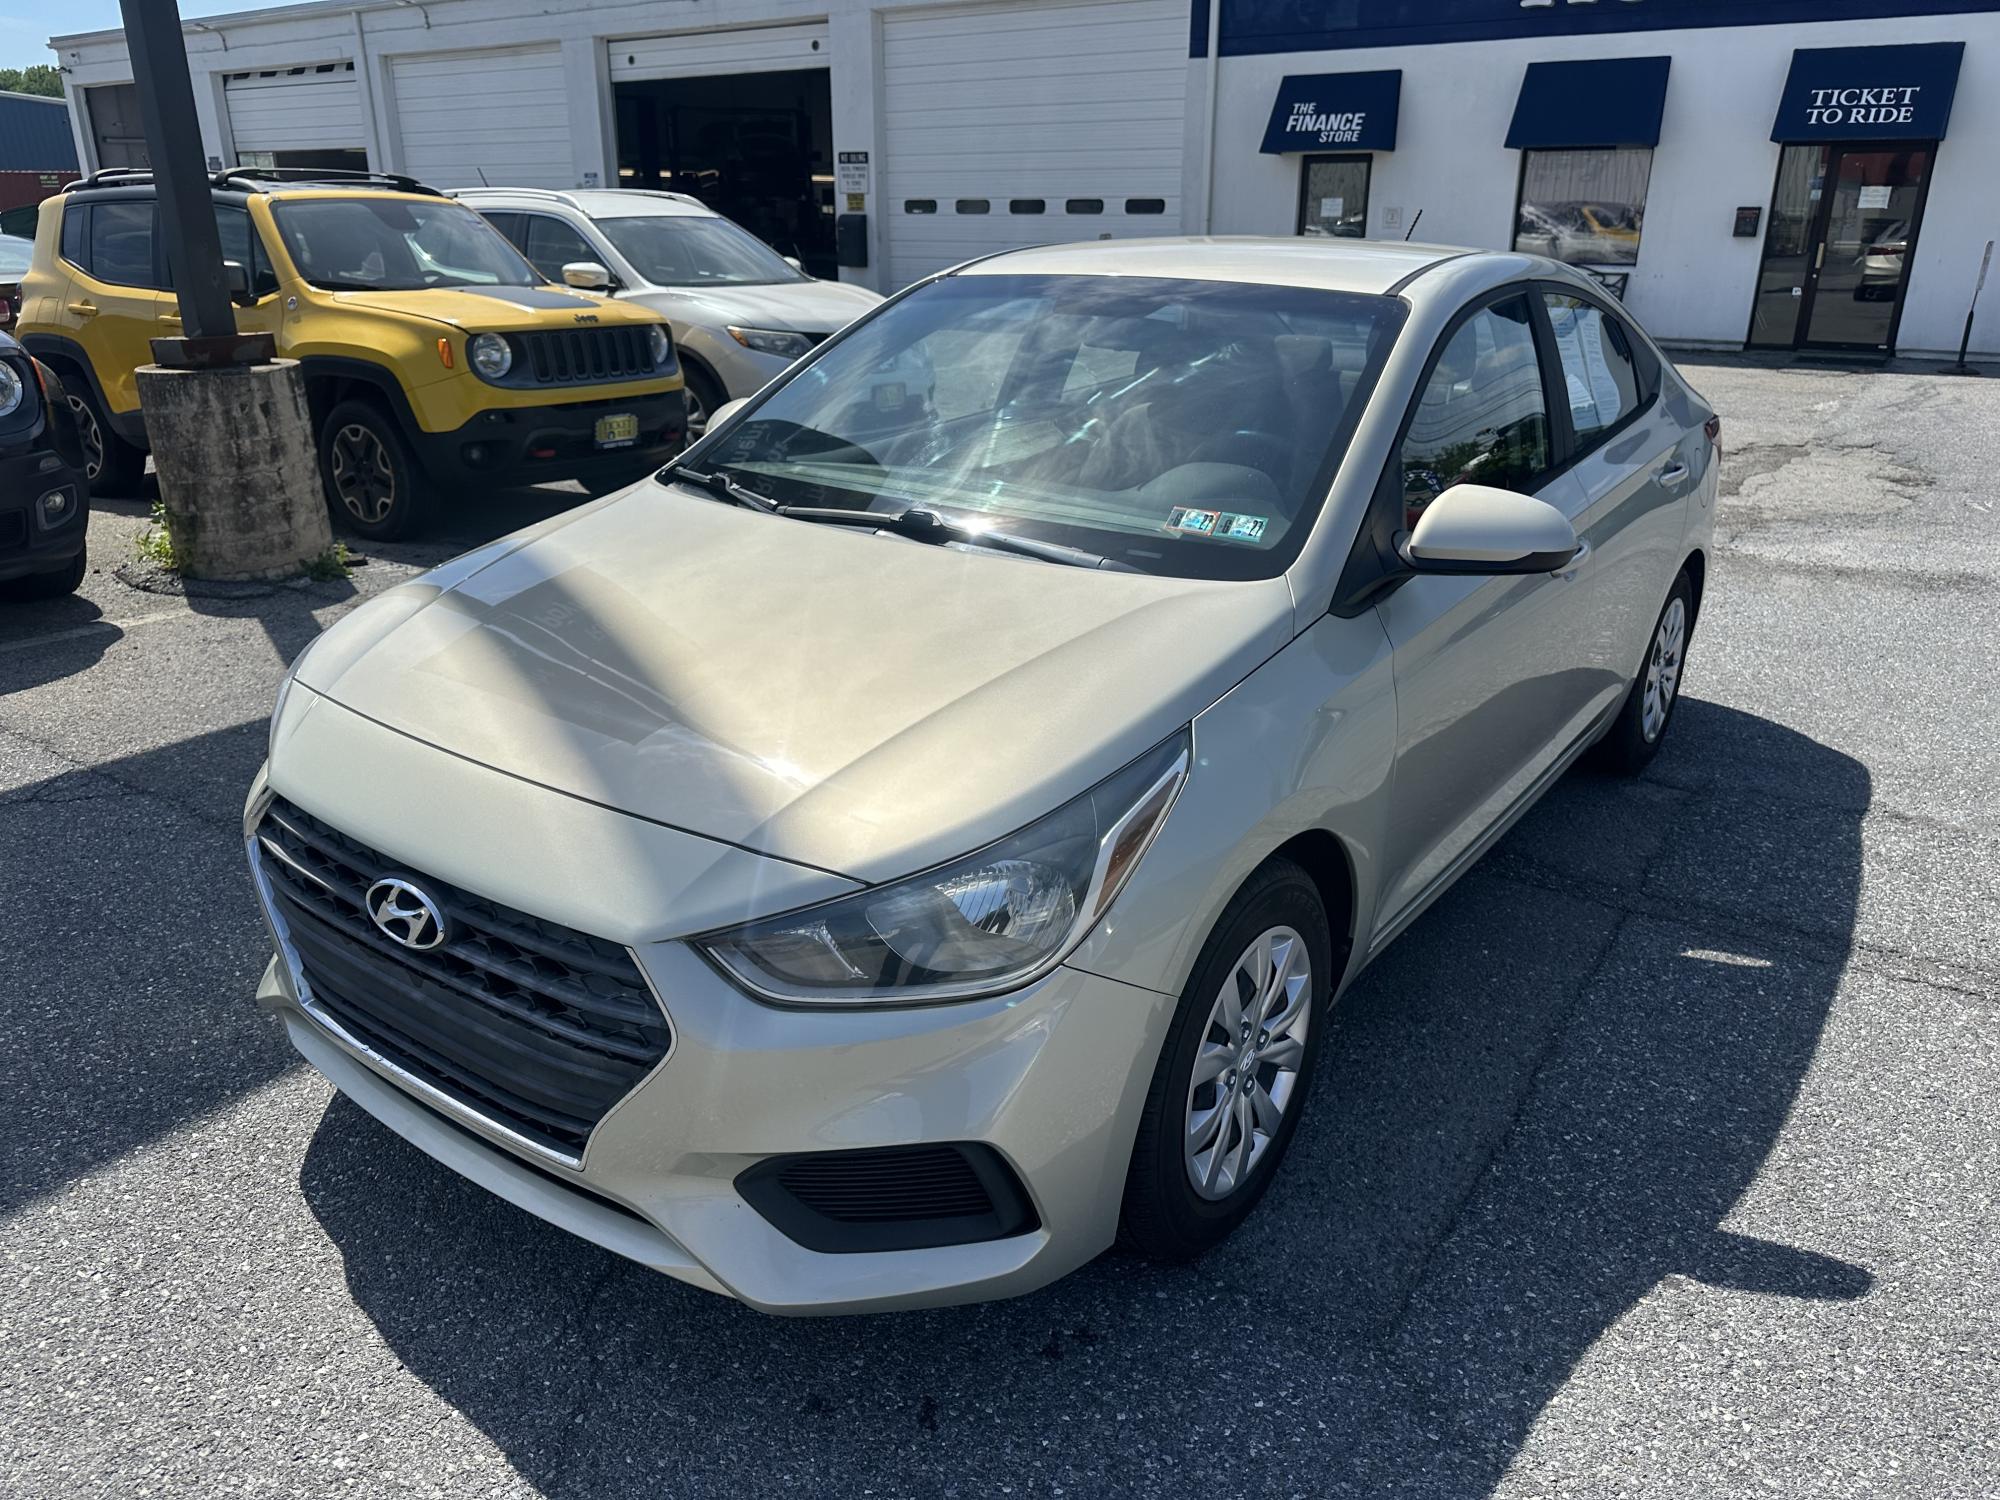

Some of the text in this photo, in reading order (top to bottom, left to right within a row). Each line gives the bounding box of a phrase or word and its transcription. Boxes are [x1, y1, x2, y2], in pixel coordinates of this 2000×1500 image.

[1811, 86, 1921, 106] TICKET
[1292, 102, 1317, 115] THE
[1806, 106, 1914, 125] TO RIDE
[1285, 112, 1366, 132] FINANCE
[1318, 130, 1361, 143] STORE
[574, 313, 599, 323] Jeep
[1198, 514, 1214, 531] 27
[1248, 520, 1264, 536] 27
